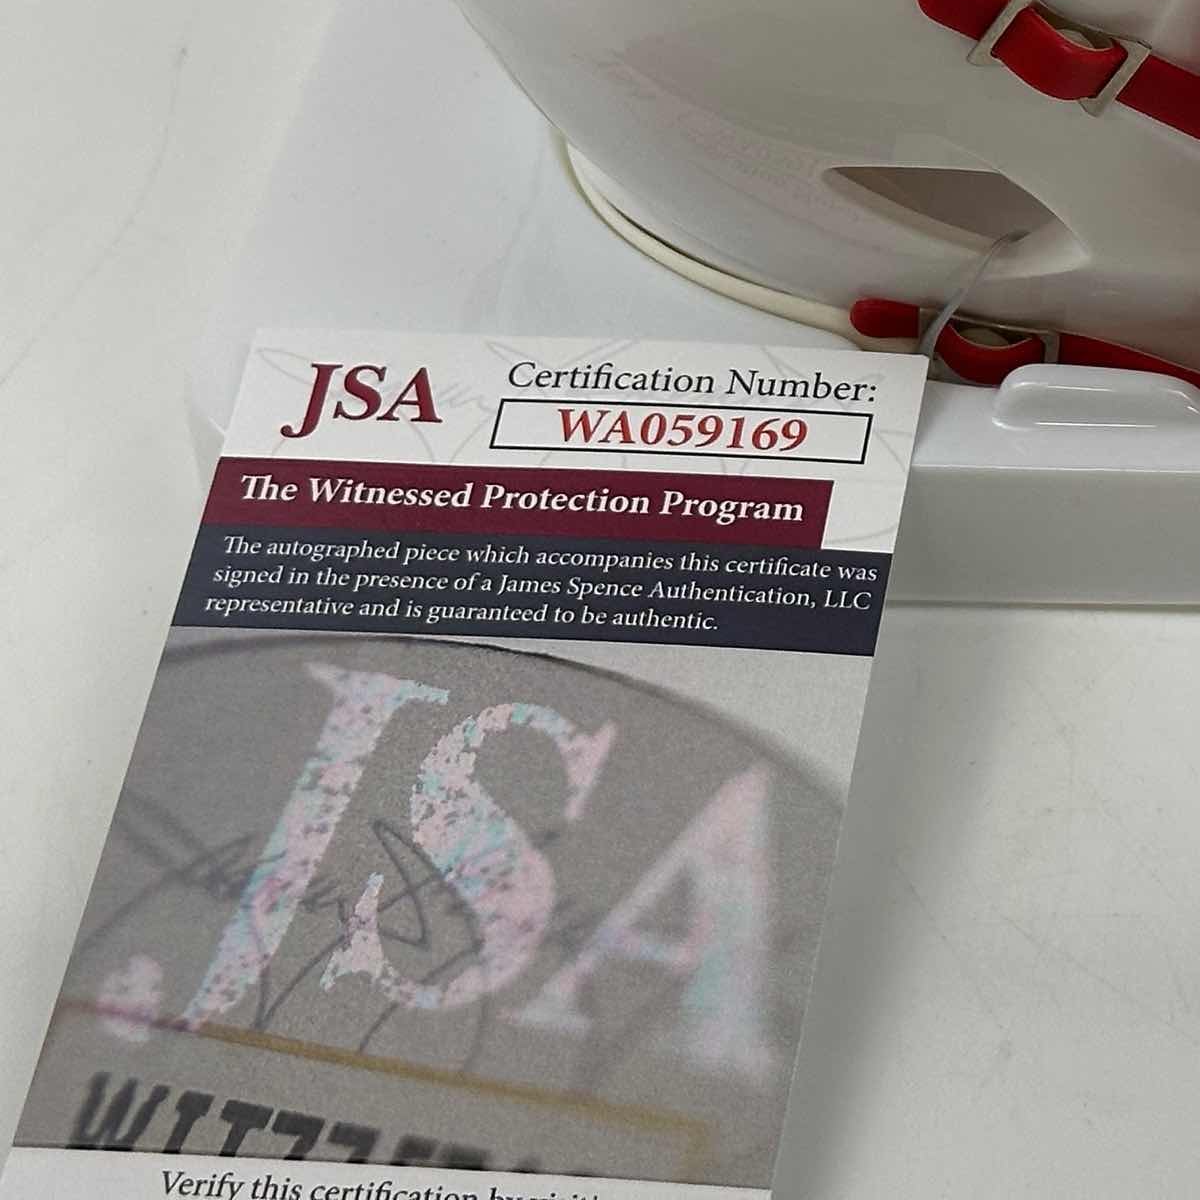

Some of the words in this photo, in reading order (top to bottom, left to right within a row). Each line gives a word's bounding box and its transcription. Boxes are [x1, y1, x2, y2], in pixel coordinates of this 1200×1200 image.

[280, 363, 443, 438] JSA
[508, 362, 715, 394] Certification
[725, 369, 877, 402] Number:
[558, 408, 809, 452] WA059169
[240, 474, 298, 500] The
[309, 478, 473, 508] Witnessed
[480, 484, 649, 514] Protection
[659, 490, 804, 525] Program
[223, 536, 261, 555] The
[267, 540, 400, 563] autographed
[402, 543, 460, 566] piece
[465, 545, 529, 565] which
[536, 552, 674, 573] accompanies
[679, 553, 720, 573] this
[724, 557, 832, 579] certificate
[838, 565, 878, 582] was
[212, 565, 284, 588] signed
[287, 567, 311, 584] in
[316, 567, 350, 586] the
[353, 572, 449, 593] presence
[453, 571, 482, 592] of
[480, 577, 493, 592] a
[496, 574, 562, 597] James
[566, 577, 643, 600] Spence
[647, 580, 817, 610] Authentication,
[823, 590, 873, 611] LLC
[205, 596, 354, 616] representative
[359, 599, 401, 617] and
[405, 600, 422, 618] is
[425, 603, 547, 624] guaranteed
[554, 606, 575, 624] to
[581, 605, 607, 625] be
[612, 609, 719, 631] authentic.
[162, 1170, 244, 1200] Verify
[250, 1175, 303, 1200] this
